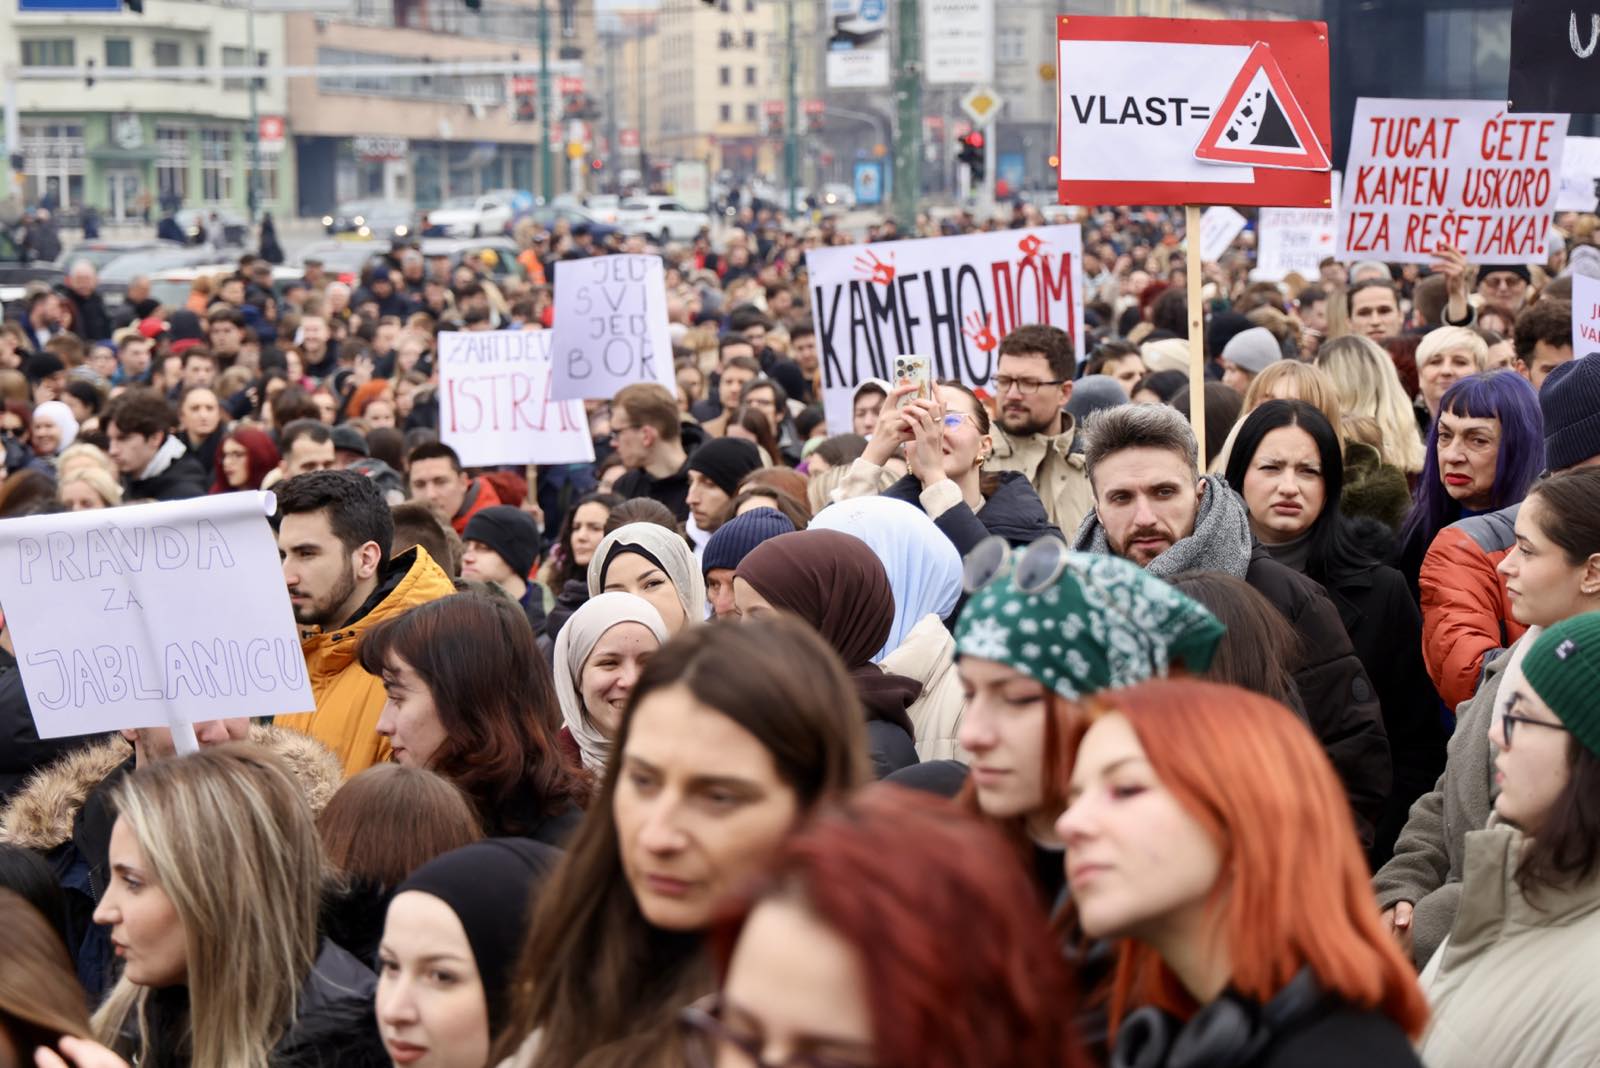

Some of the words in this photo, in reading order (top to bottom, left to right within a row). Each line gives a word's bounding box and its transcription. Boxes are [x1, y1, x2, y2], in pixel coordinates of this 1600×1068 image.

[1071, 95, 1210, 126] VLAST=
[1370, 118, 1460, 159] TUCAT
[1481, 112, 1555, 162] ĆETE
[1354, 166, 1449, 206] KAMEN
[1462, 168, 1551, 209] USKORO
[1346, 212, 1390, 252] IZA
[1404, 208, 1550, 255] REŠETAKA!
[574, 284, 649, 316] SVI
[447, 332, 554, 363] ZAHTIJEV
[567, 336, 658, 381] BOR
[17, 518, 236, 584] PRAVDA
[101, 588, 143, 611] ZA
[26, 637, 304, 711] JABLANICU
